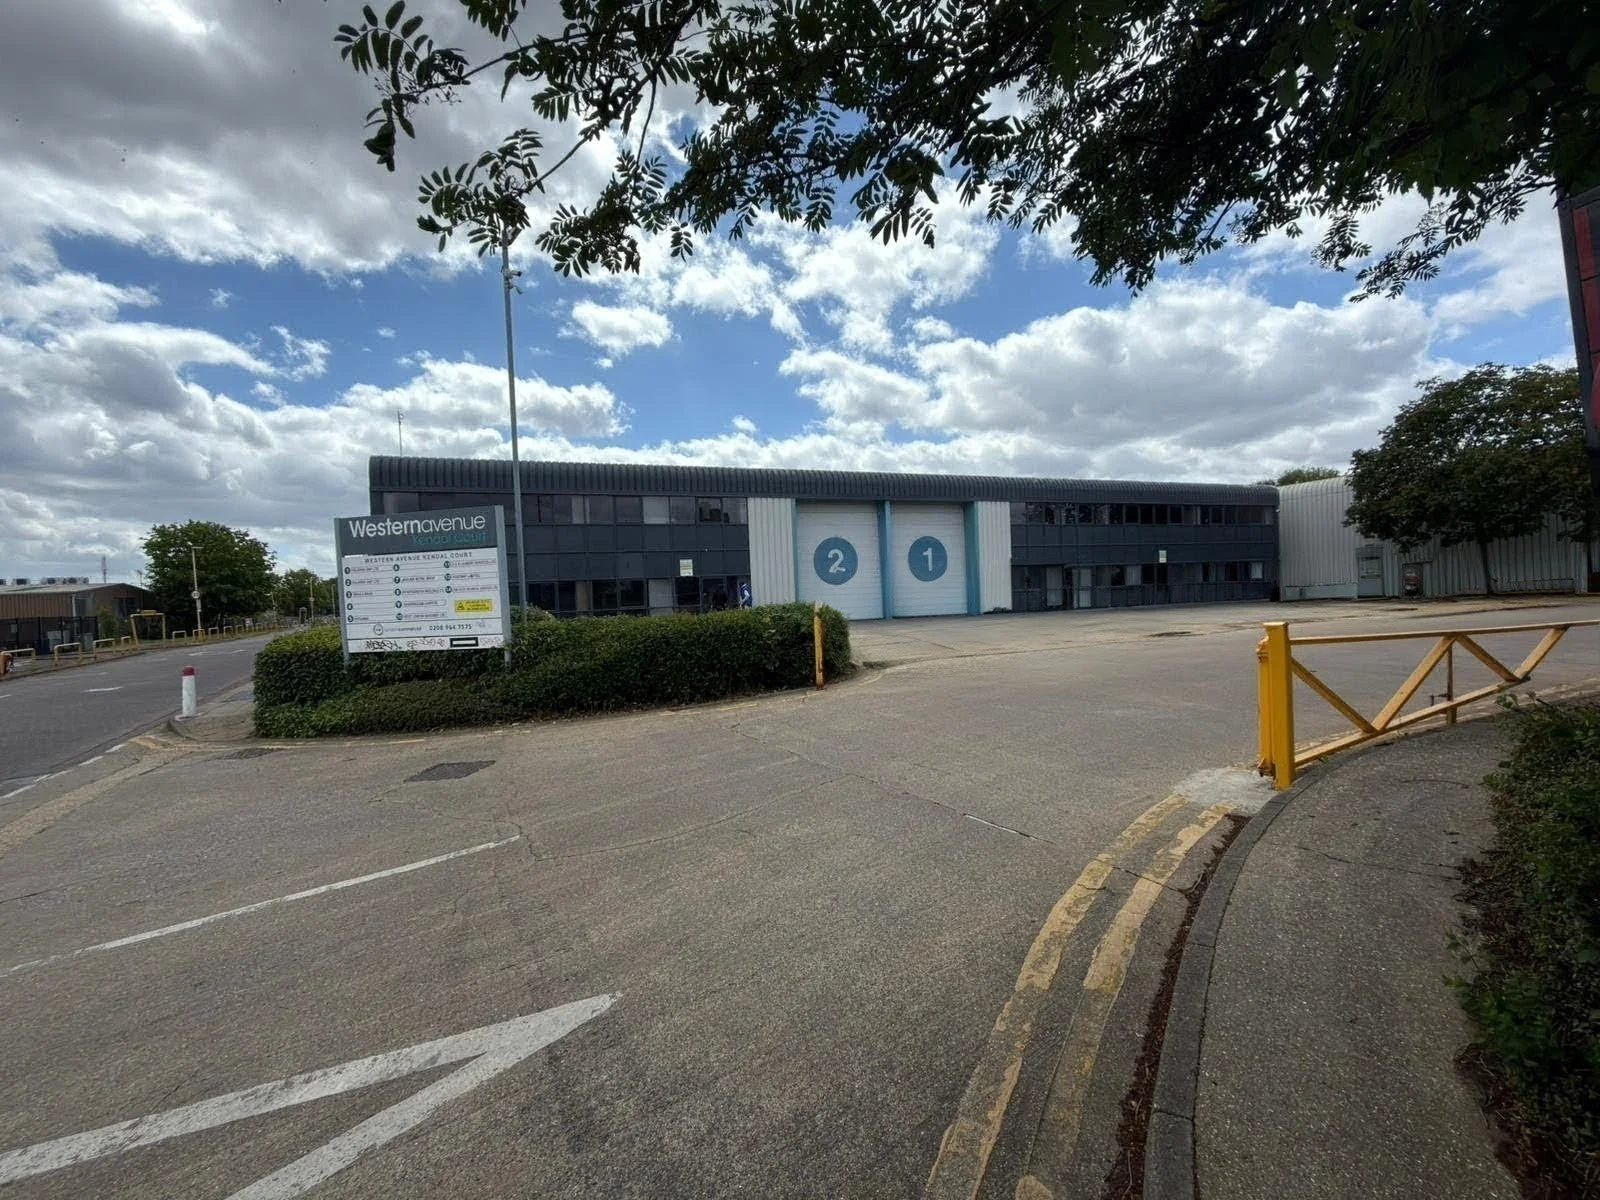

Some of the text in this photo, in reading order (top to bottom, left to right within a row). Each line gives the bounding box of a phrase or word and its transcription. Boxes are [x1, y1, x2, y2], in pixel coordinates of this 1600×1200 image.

[349, 515, 486, 538] Westernavenue
[827, 548, 846, 573] 2
[922, 547, 933, 571] 1
